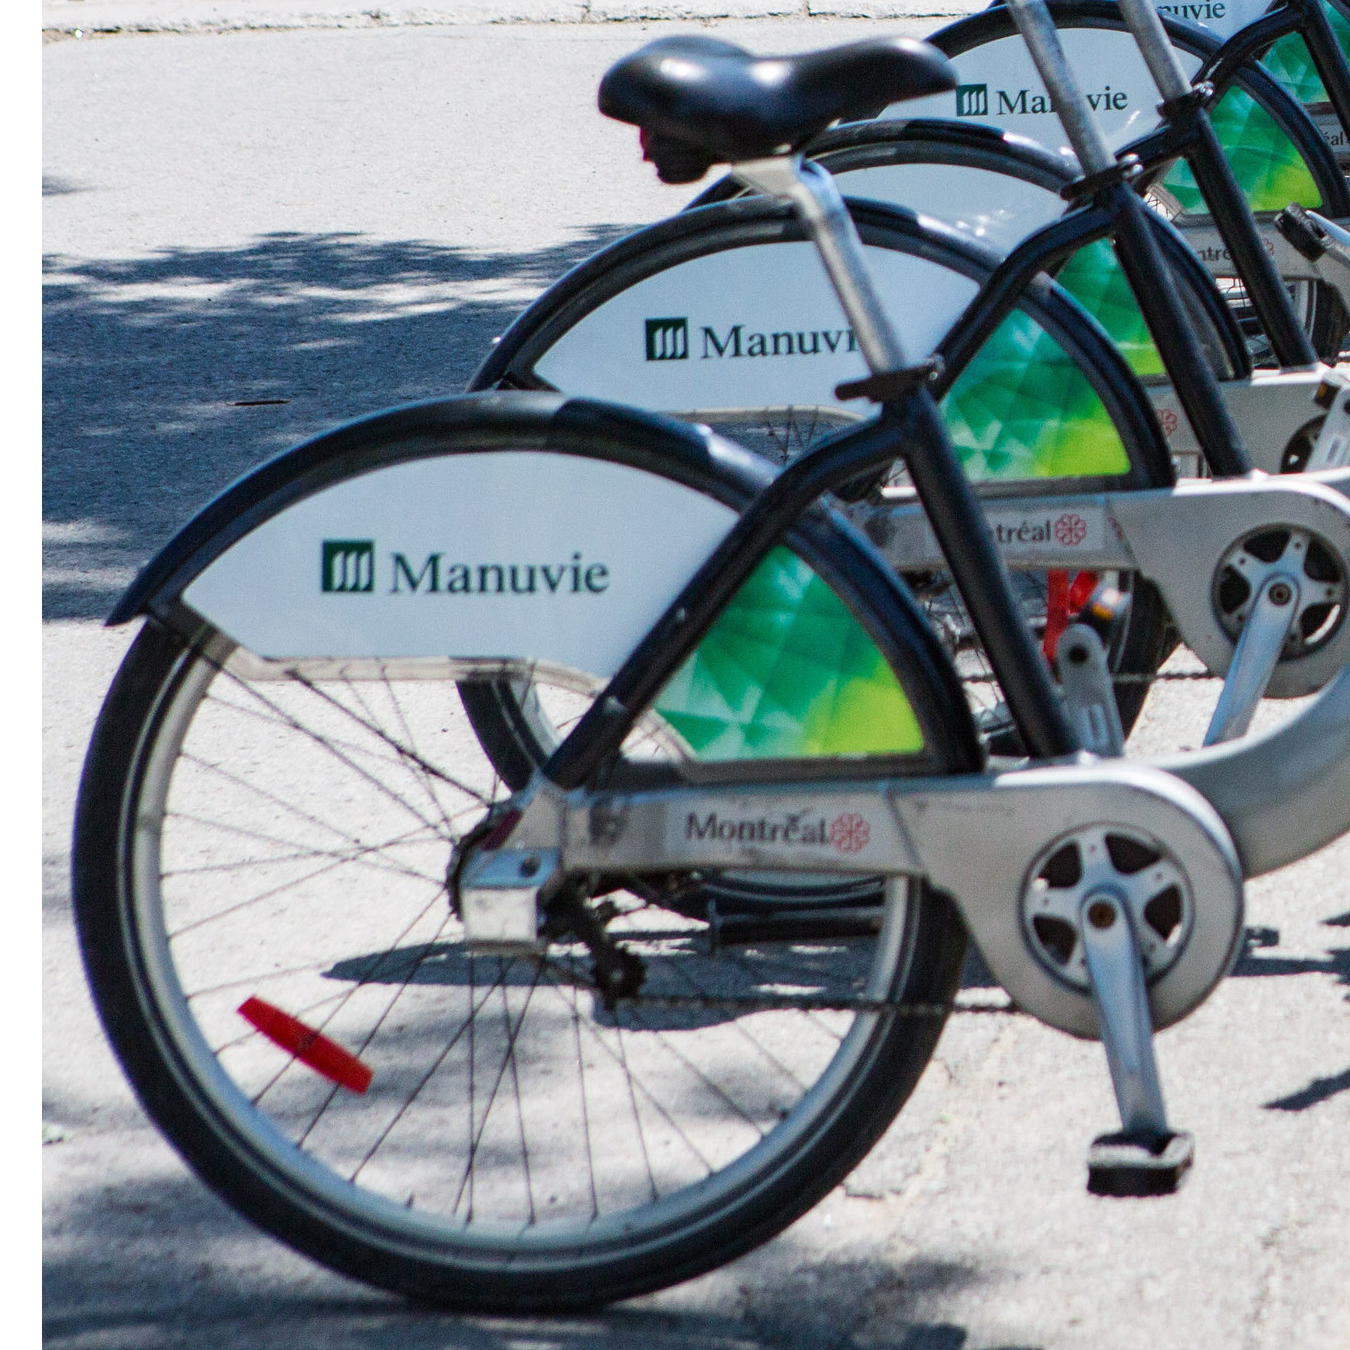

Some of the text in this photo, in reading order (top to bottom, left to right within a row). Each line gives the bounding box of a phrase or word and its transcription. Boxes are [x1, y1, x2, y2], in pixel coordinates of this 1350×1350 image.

[996, 85, 1128, 116] Mavie
[700, 324, 859, 359] Manuvi
[996, 519, 1051, 545] tréal
[389, 551, 610, 594] Manuvie
